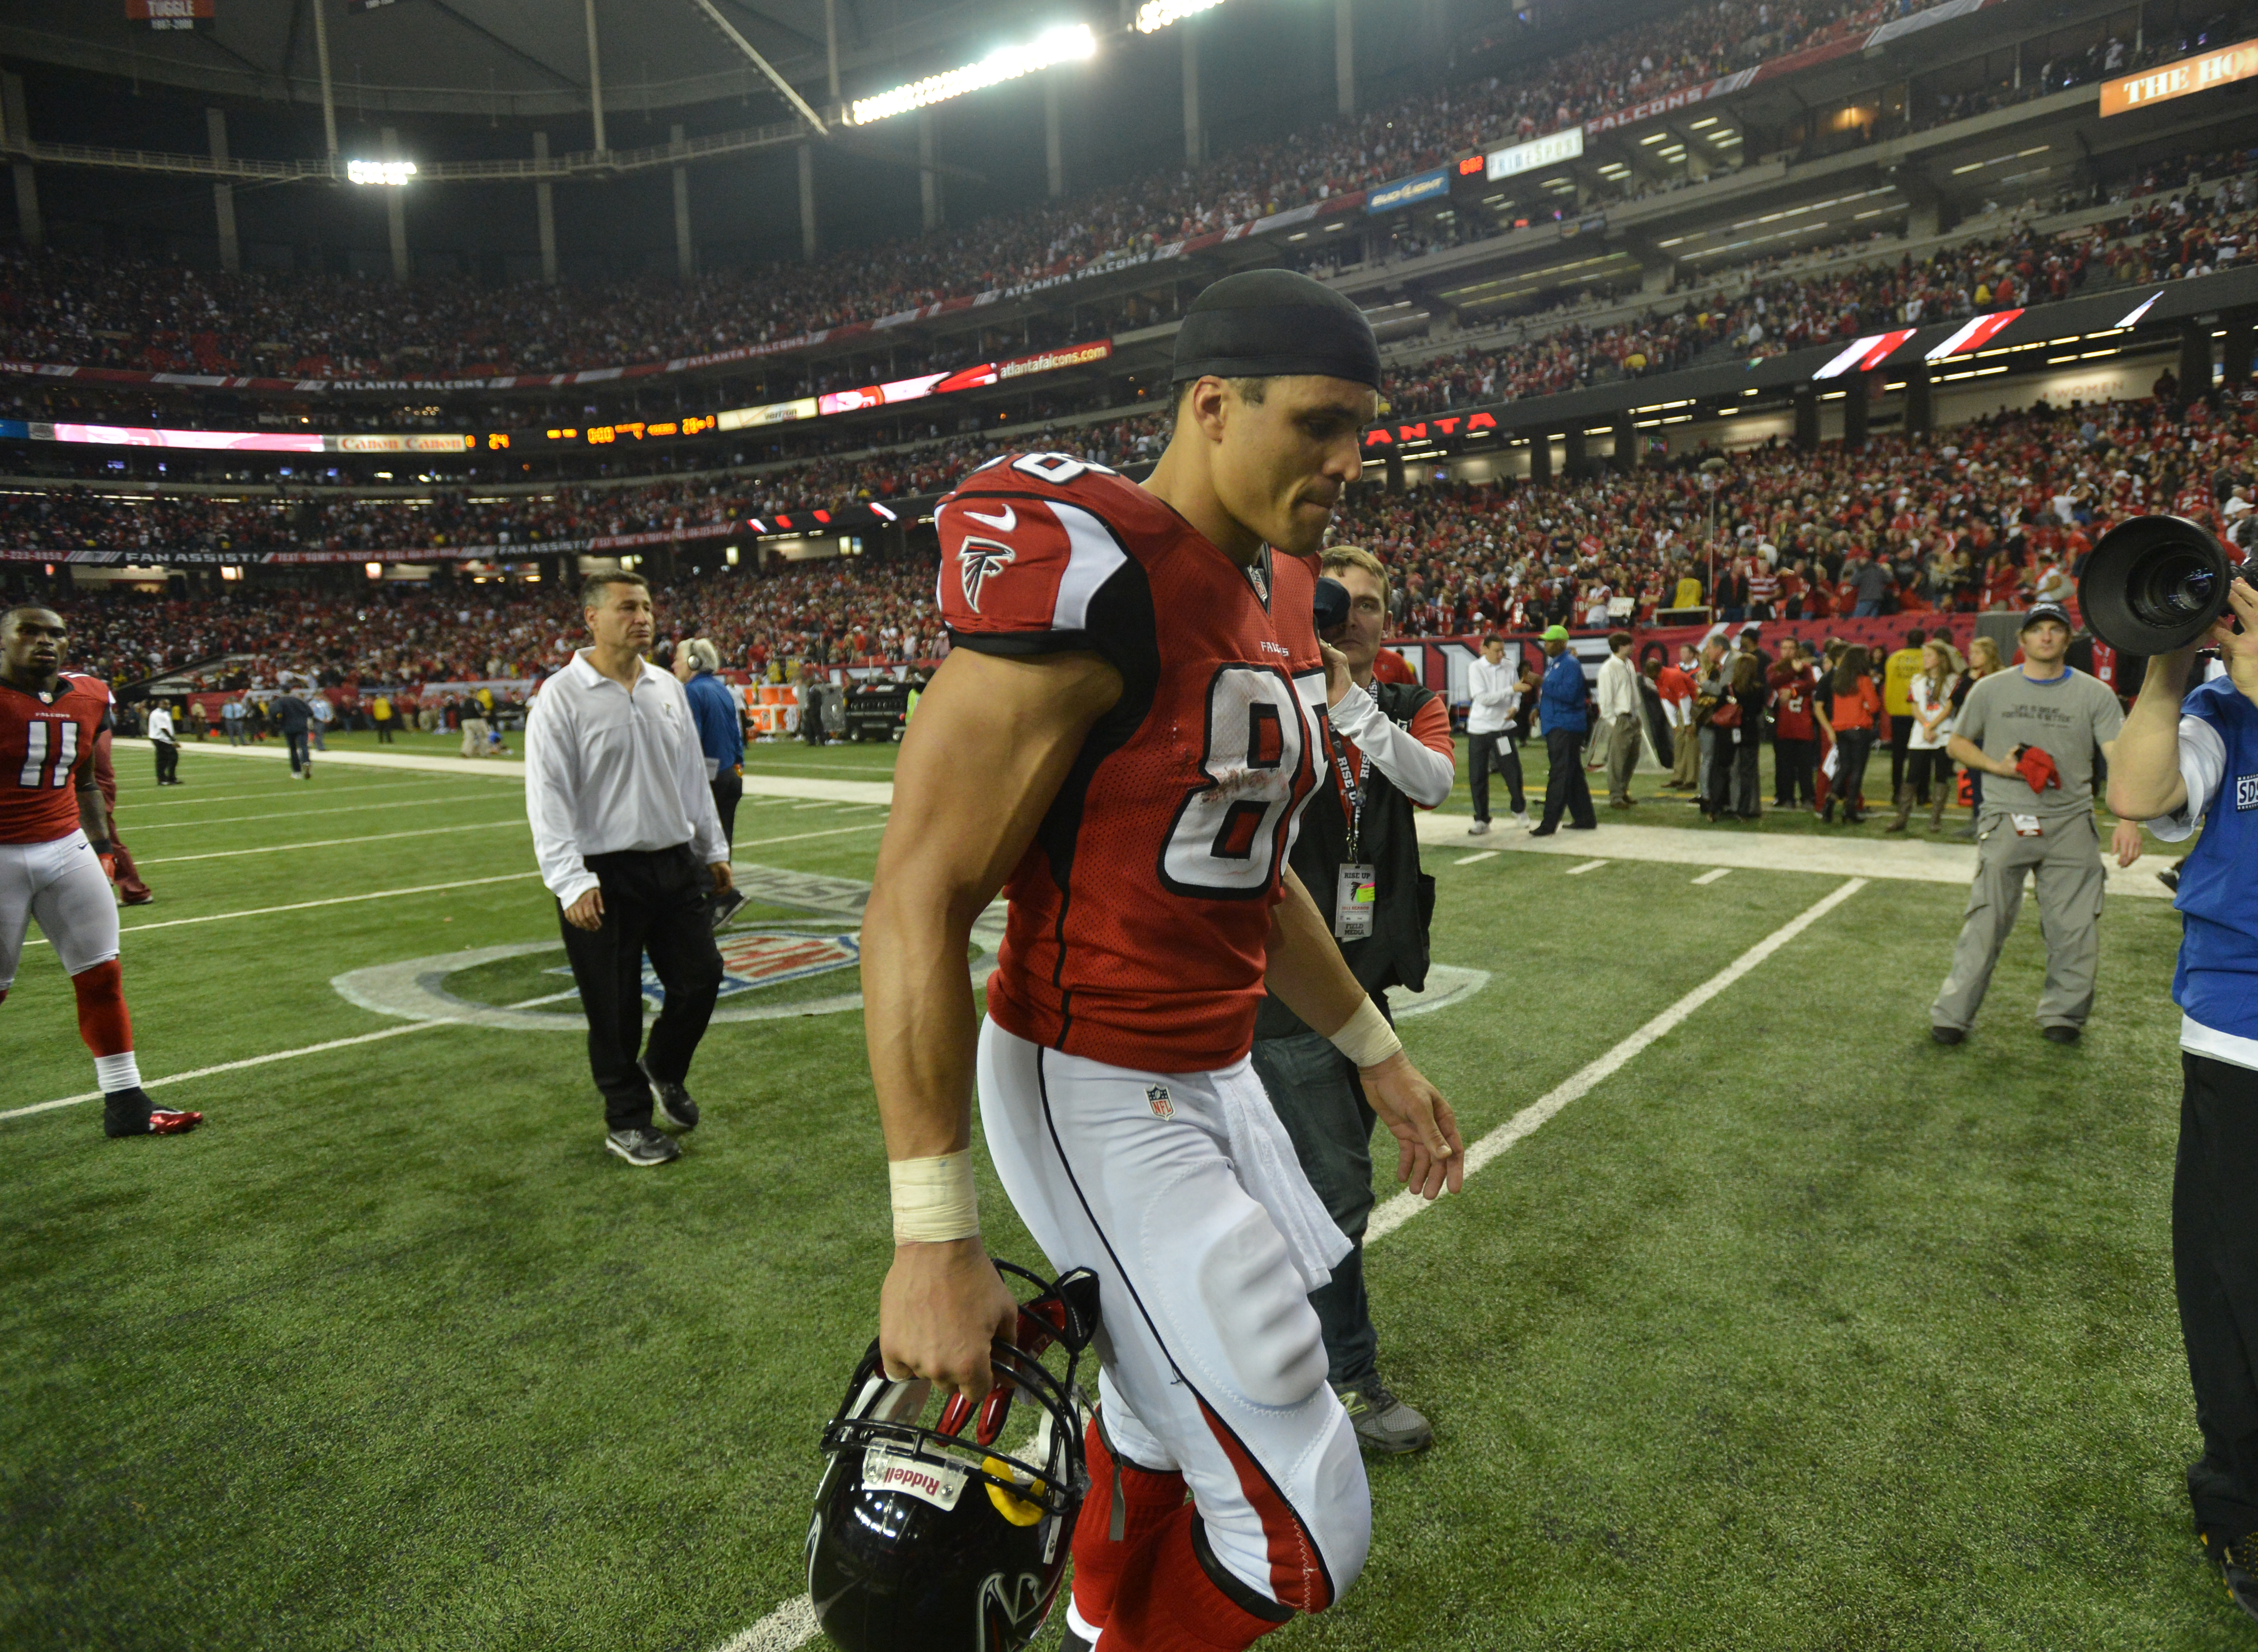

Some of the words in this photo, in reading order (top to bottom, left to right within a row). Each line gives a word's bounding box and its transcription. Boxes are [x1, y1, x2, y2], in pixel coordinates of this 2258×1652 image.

[147, 0, 195, 17] TUGGLE
[2123, 65, 2189, 105] THE
[1587, 88, 1702, 135] FALCONS
[1371, 189, 1401, 207] BUD
[1400, 176, 1445, 199] LIGHT
[1004, 273, 1072, 298] ATLANTA
[1076, 251, 1149, 280] FALCONS
[689, 349, 745, 365] ATLANTA
[749, 336, 806, 356] FALCONS
[1000, 346, 1107, 379] atlantafalcons.com
[0, 363, 34, 373] NS
[334, 381, 408, 390] ATLANTA
[414, 378, 485, 390] FALCONS
[2054, 380, 2124, 398] WOMEN
[1357, 412, 1497, 446] ANTA
[341, 438, 400, 450] Canon
[405, 438, 461, 450] Canon
[125, 553, 169, 562] FAN
[175, 553, 258, 562] ASSIST!
[498, 545, 529, 555] FAN
[19, 720, 78, 789] 11
[1337, 755, 1356, 788] RISE
[2238, 780, 2258, 803] SD
[1152, 1100, 1172, 1116] NFL
[883, 1467, 940, 1497] Riddell
